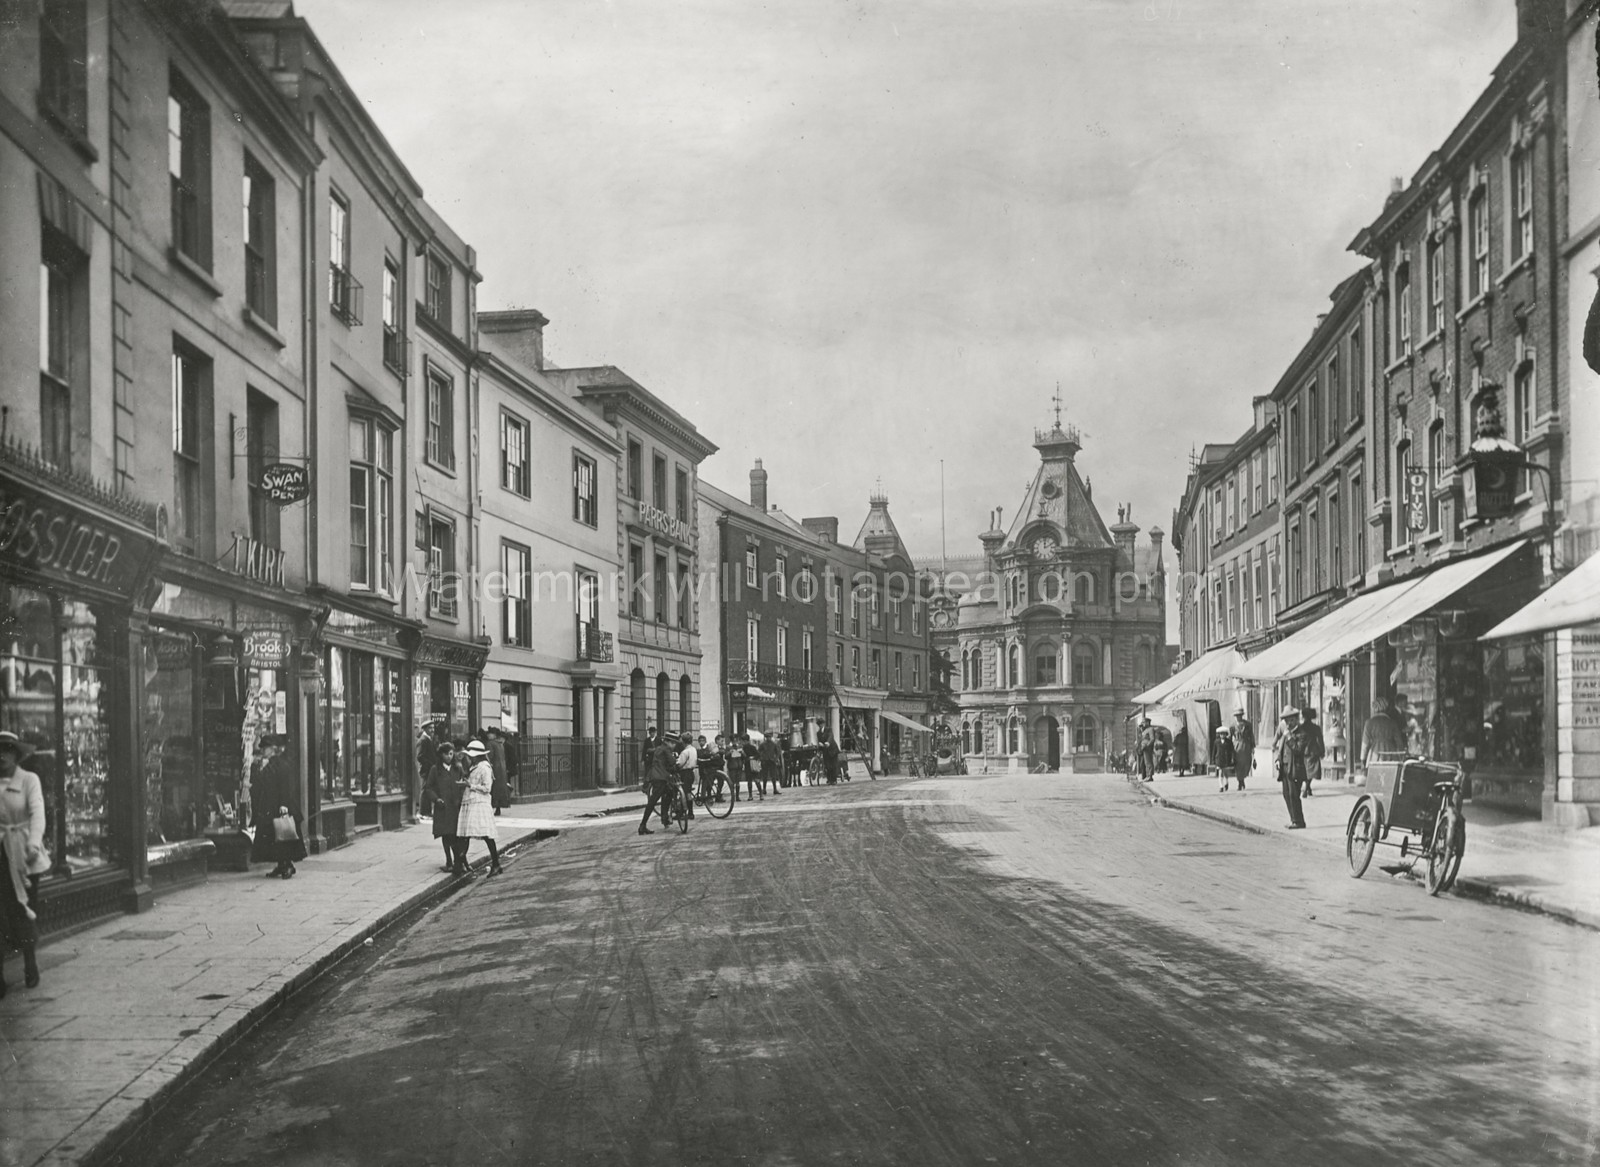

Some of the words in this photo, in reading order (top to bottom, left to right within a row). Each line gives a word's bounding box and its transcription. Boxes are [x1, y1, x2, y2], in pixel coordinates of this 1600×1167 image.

[261, 471, 303, 490] SWAN
[271, 489, 295, 500] PEN
[1410, 474, 1424, 530] OLIVER
[670, 516, 691, 546] BANK
[250, 659, 282, 668] BRISTOL
